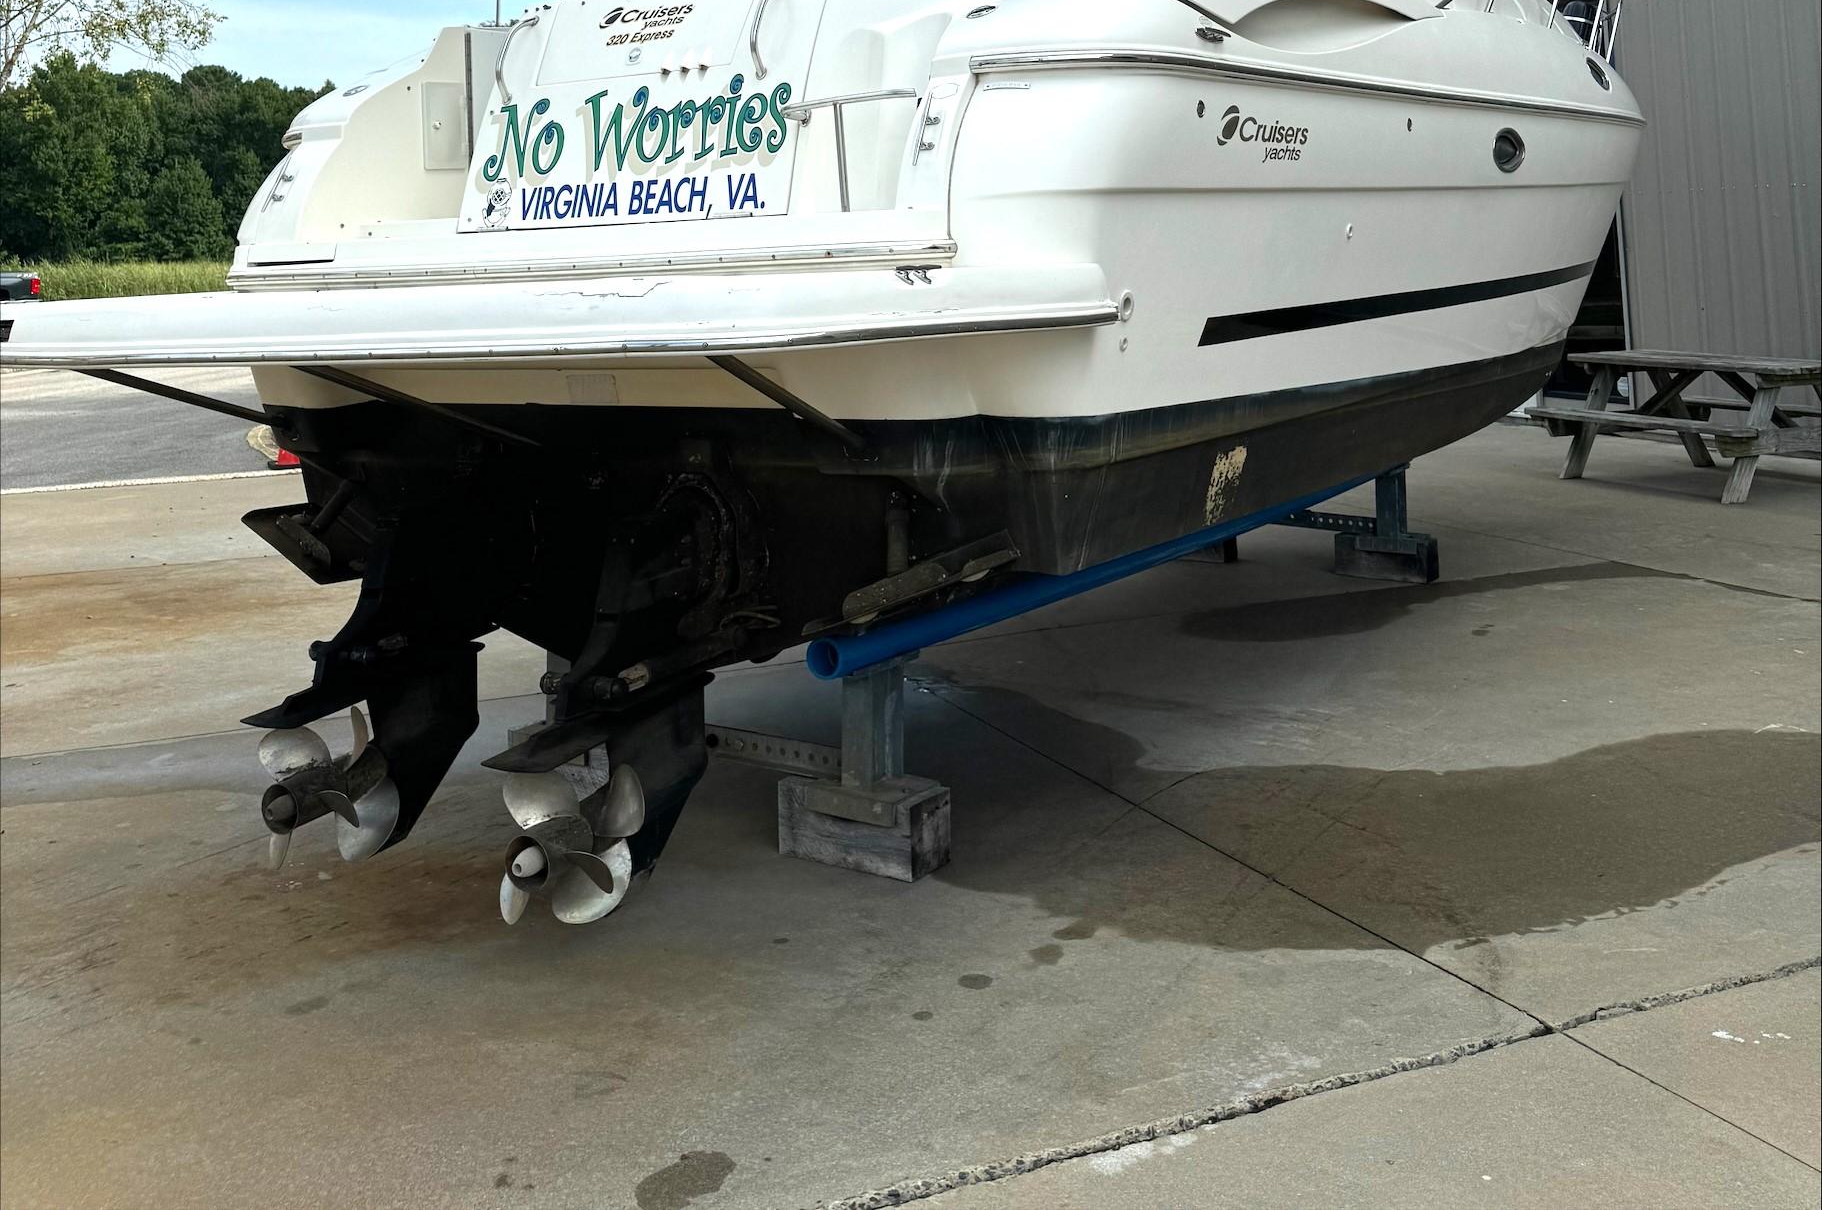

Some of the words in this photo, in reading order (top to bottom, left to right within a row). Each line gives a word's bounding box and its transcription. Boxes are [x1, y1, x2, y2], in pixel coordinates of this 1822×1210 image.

[621, 3, 694, 24] Cruisers
[641, 16, 685, 31] yachts
[606, 33, 629, 46] 320
[629, 29, 675, 44] Express
[483, 98, 564, 182] No
[585, 73, 792, 172] Worries
[1239, 116, 1309, 146] Cruisers
[1262, 145, 1301, 164] yachts
[521, 183, 619, 220] VIRGINIA
[628, 177, 713, 220] BEACH,
[727, 173, 766, 210] VA.
